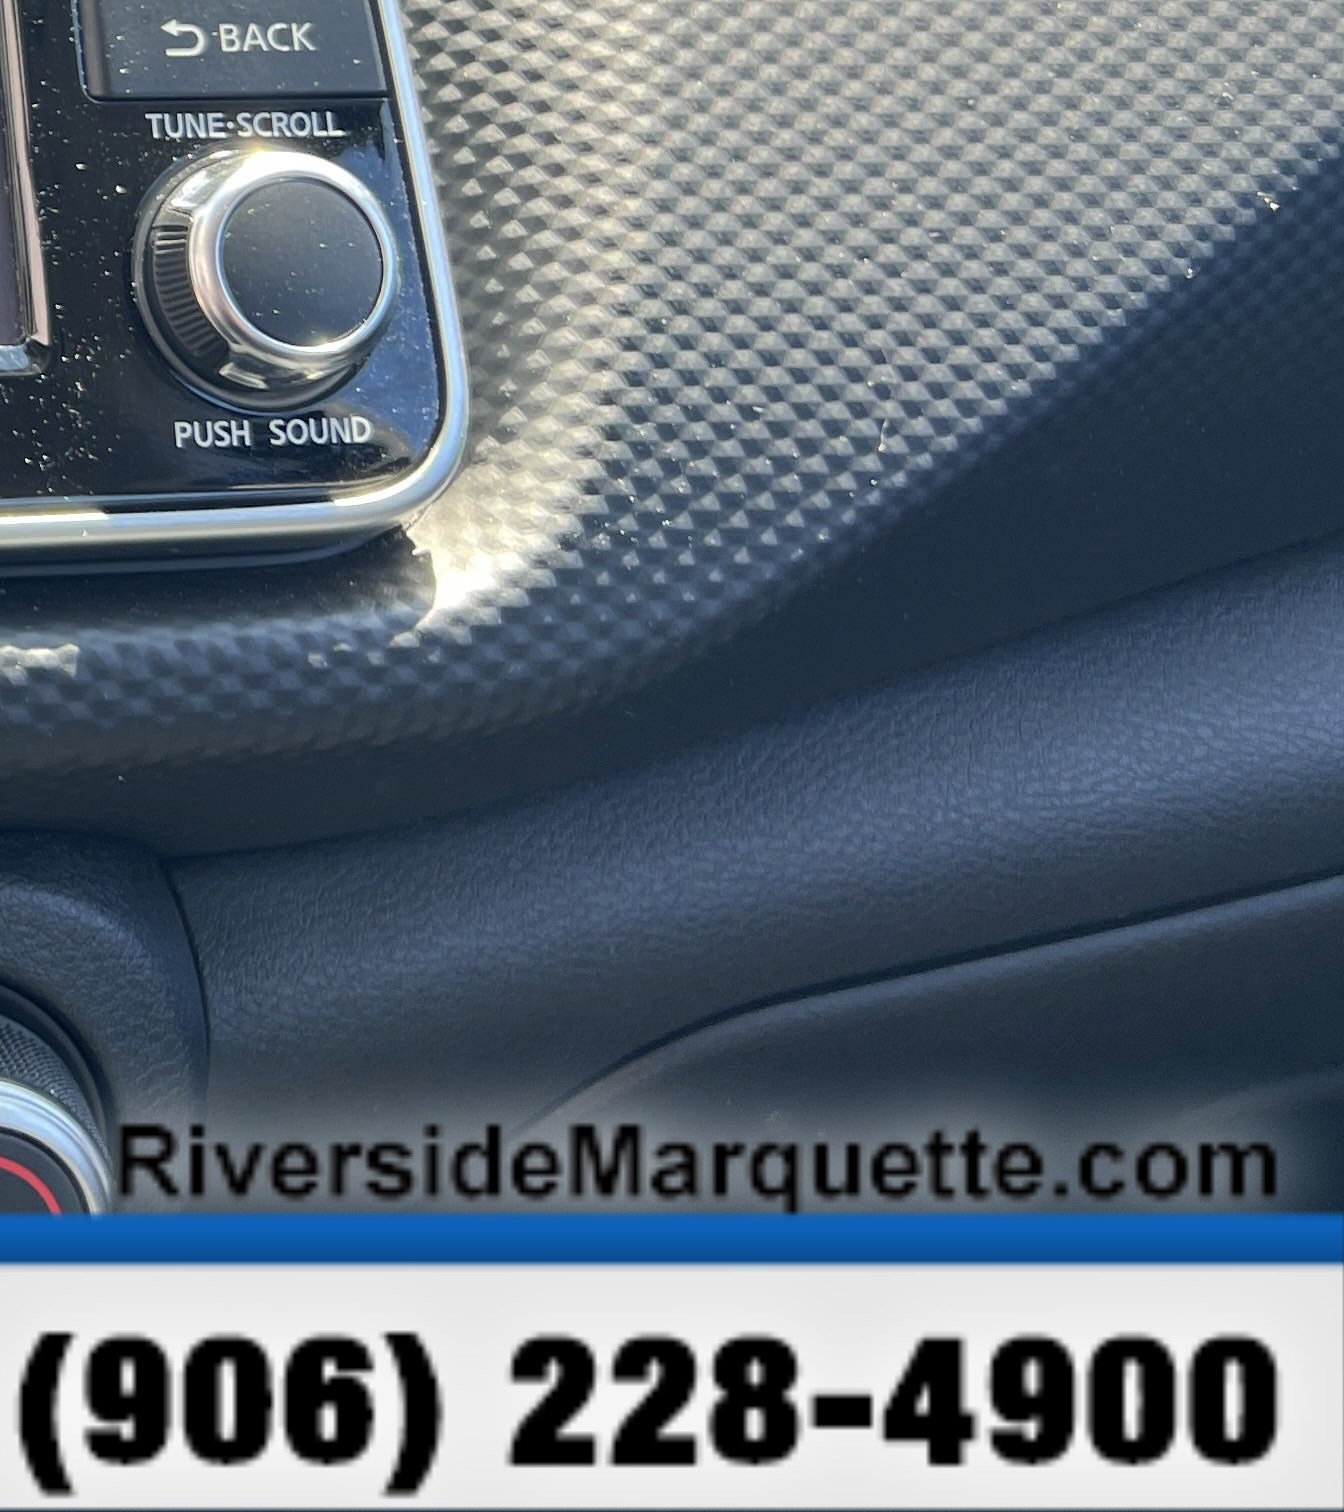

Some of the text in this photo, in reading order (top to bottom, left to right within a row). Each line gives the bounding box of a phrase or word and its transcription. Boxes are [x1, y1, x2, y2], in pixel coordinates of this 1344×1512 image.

[219, 22, 316, 53] BACK
[173, 415, 373, 448] PUSH SOUND
